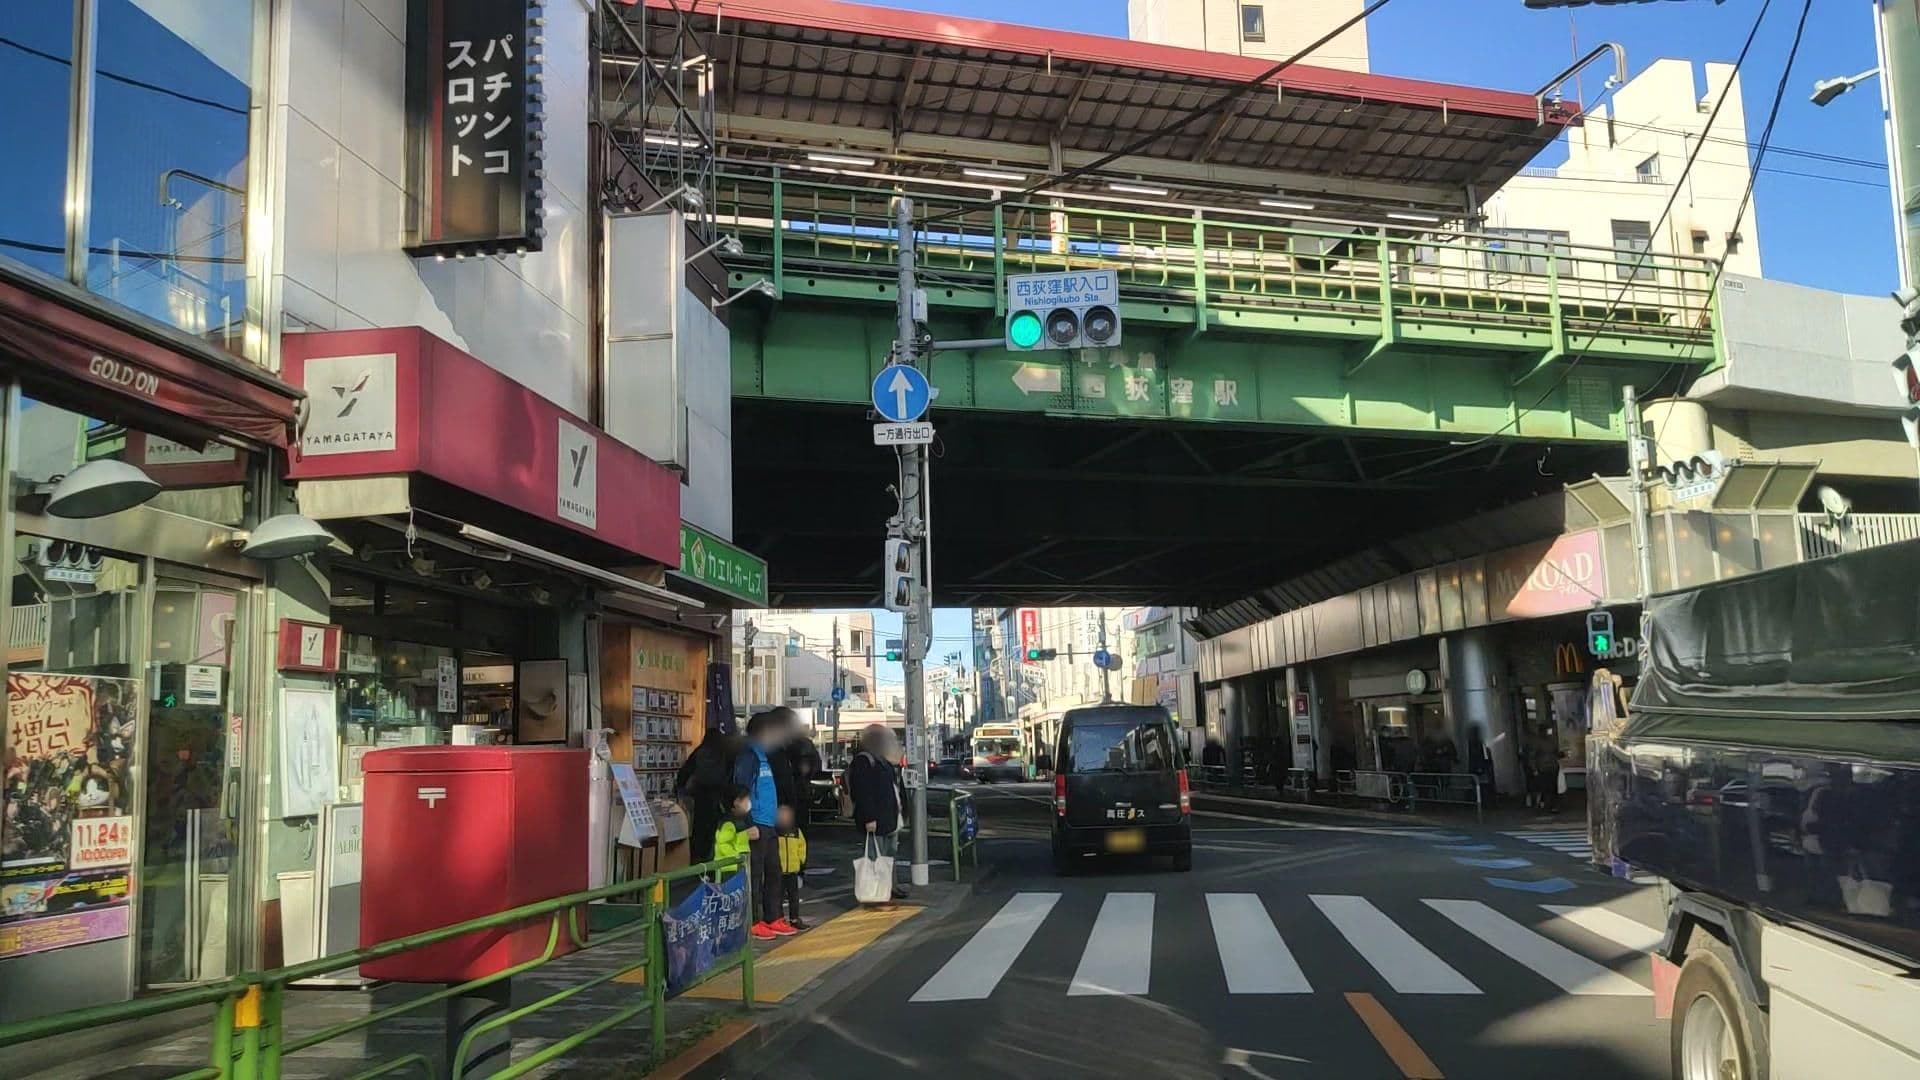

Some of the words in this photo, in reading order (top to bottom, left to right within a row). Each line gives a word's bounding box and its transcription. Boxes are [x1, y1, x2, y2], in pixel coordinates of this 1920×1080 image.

[446, 40, 477, 177] スロット
[482, 33, 514, 175] パチンコ
[1016, 275, 1108, 297] 西荻窪駅入口
[1024, 296, 1080, 307] Nishiogikubo
[89, 355, 134, 386] GOLD
[135, 371, 159, 396] ON
[1079, 374, 1239, 406] 荻窪駅
[306, 431, 394, 445] YAMAGATAYA
[877, 426, 930, 441] 一方通行出口
